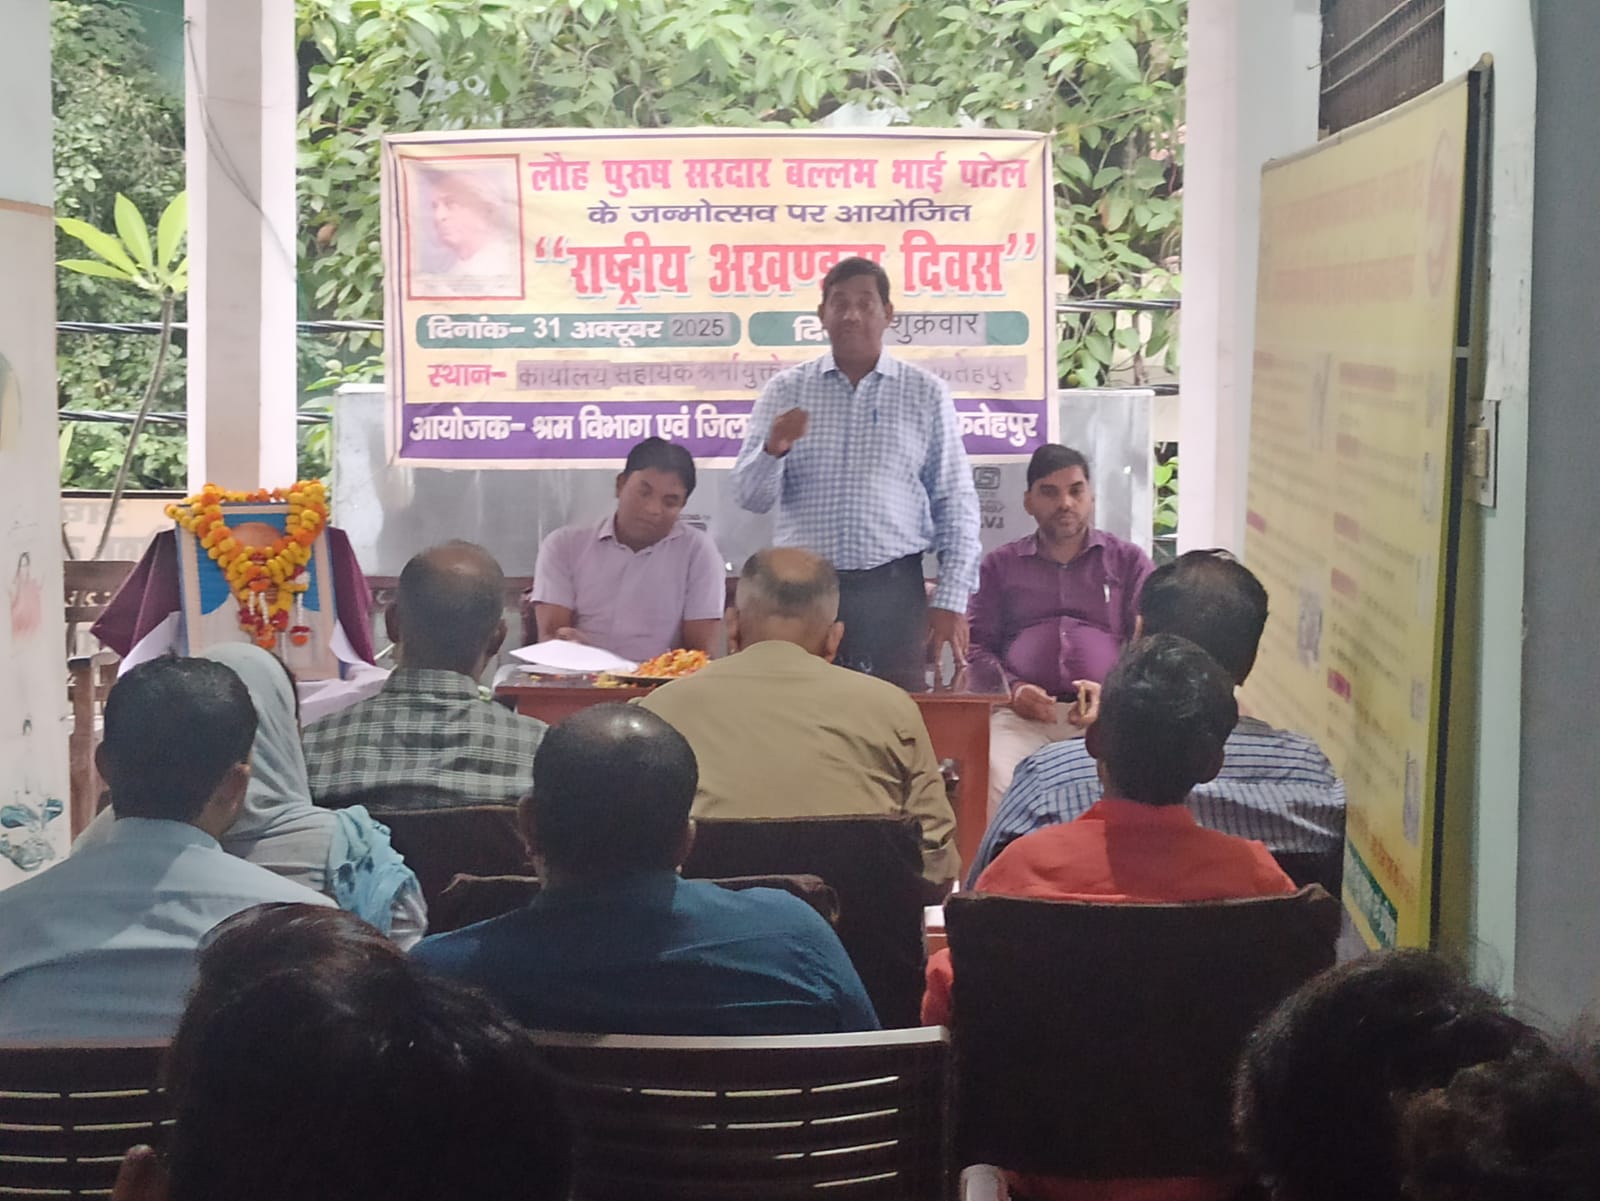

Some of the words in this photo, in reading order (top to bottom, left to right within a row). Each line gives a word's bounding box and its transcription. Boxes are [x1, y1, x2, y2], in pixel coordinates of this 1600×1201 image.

[528, 152, 590, 191] लौह
[683, 158, 772, 189] सरदार
[892, 151, 947, 193] भाई
[959, 152, 1029, 188] पटेल
[587, 200, 620, 224] के
[629, 198, 777, 224] जन्मोत्सव
[787, 203, 826, 223] पर
[835, 198, 971, 223] आयोजित
[533, 317, 560, 338] 31
[672, 318, 725, 337] 2025
[531, 414, 575, 441] श्रम
[579, 405, 652, 441] विभाग
[656, 405, 690, 441] एवं
[694, 403, 752, 440] जिल
